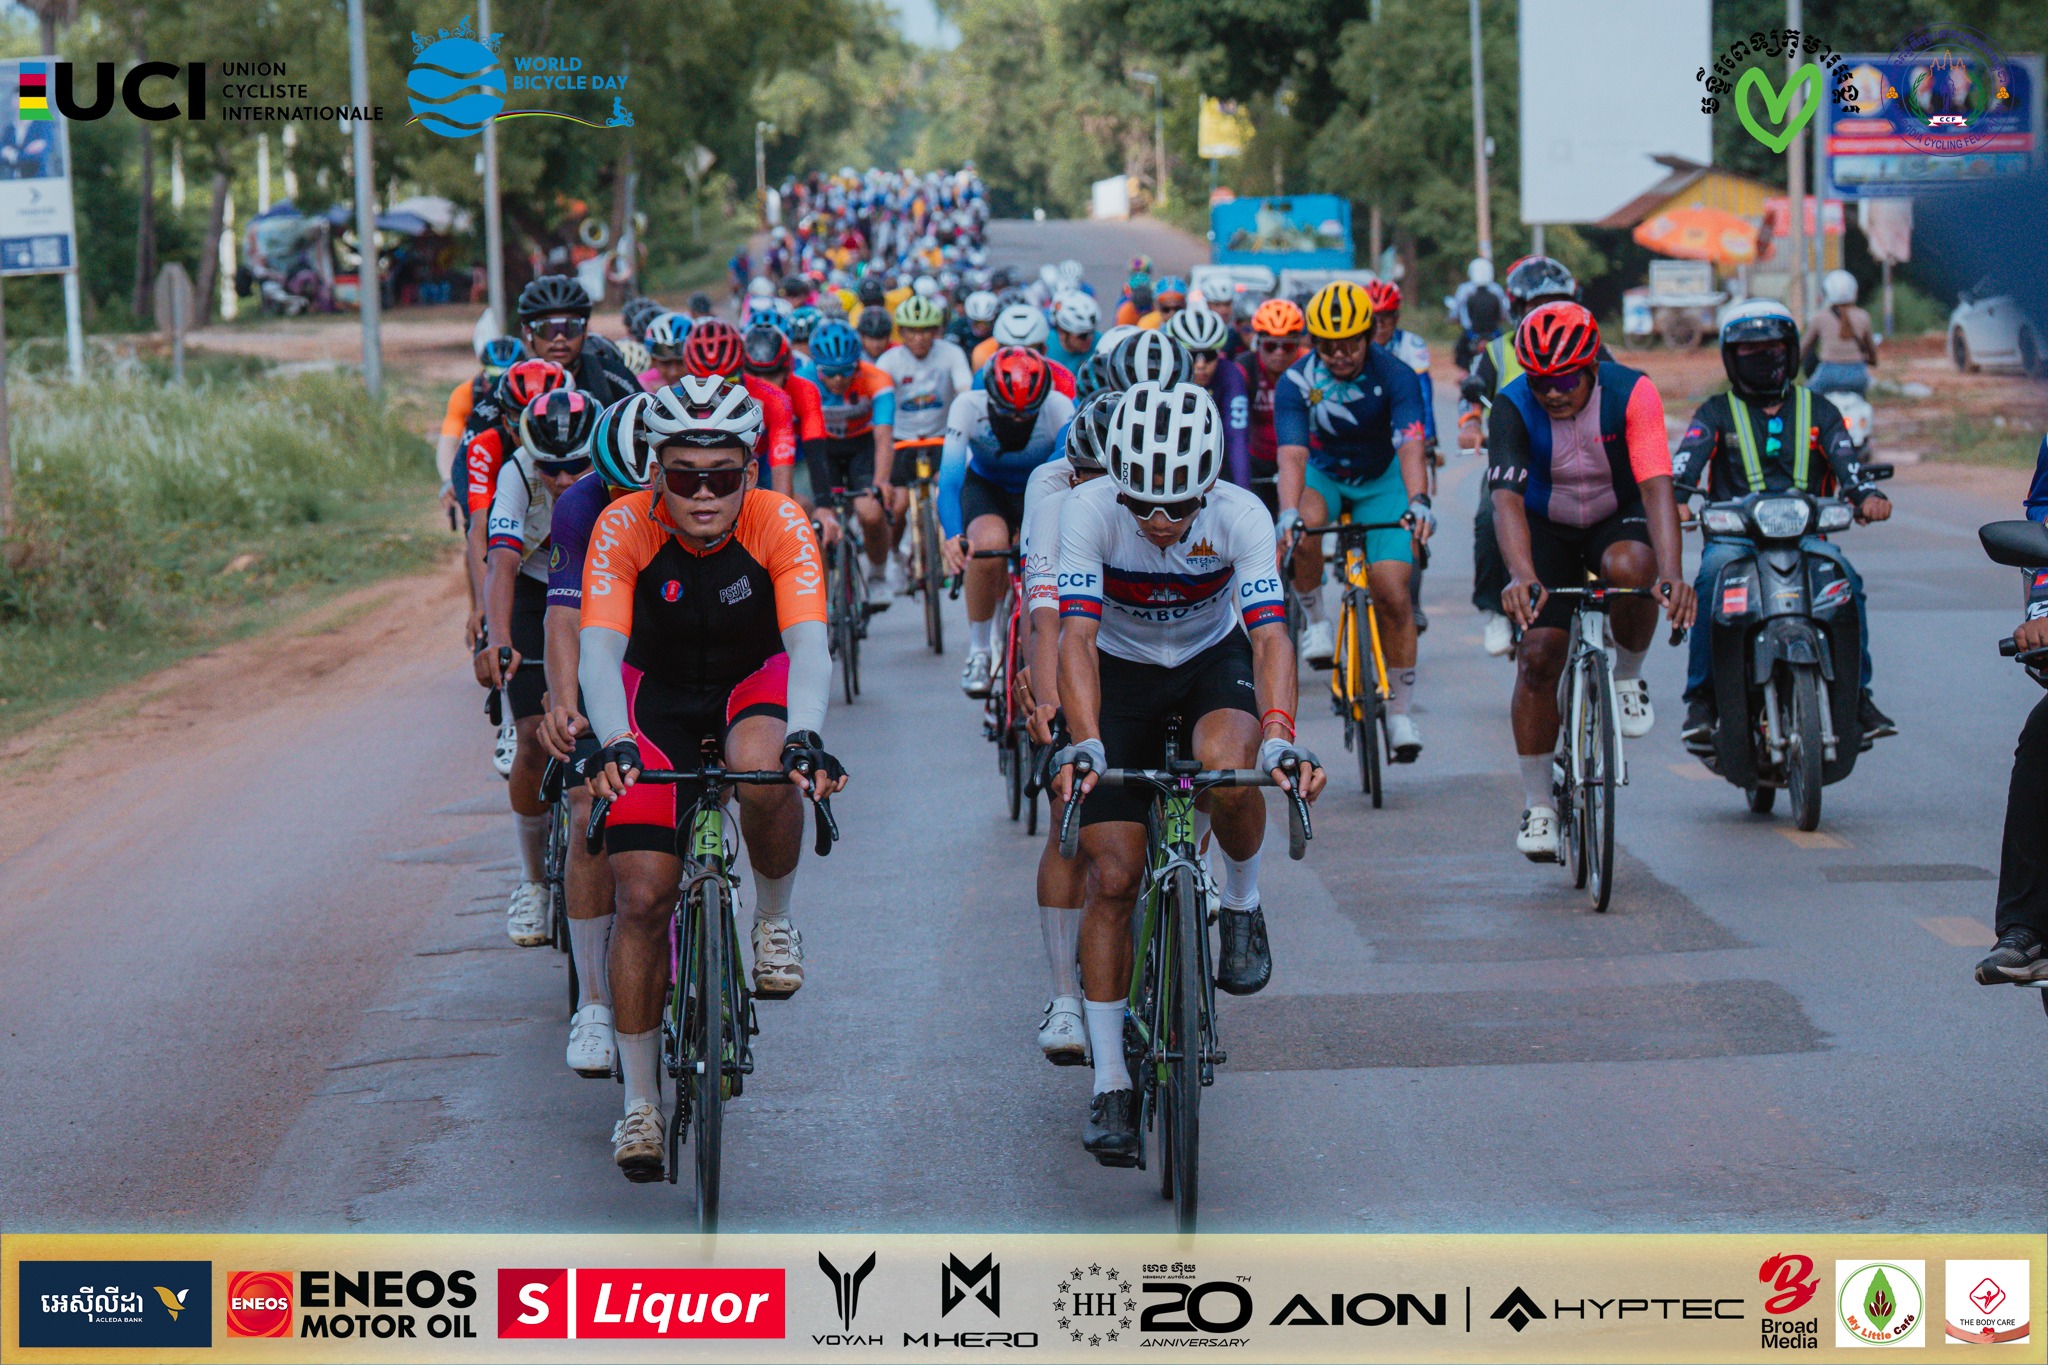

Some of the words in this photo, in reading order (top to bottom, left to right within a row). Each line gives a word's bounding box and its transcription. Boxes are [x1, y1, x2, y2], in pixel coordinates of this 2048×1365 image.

[490, 517, 519, 530] CCF
[1057, 573, 1097, 588] CCF
[1241, 578, 1279, 598] CCF
